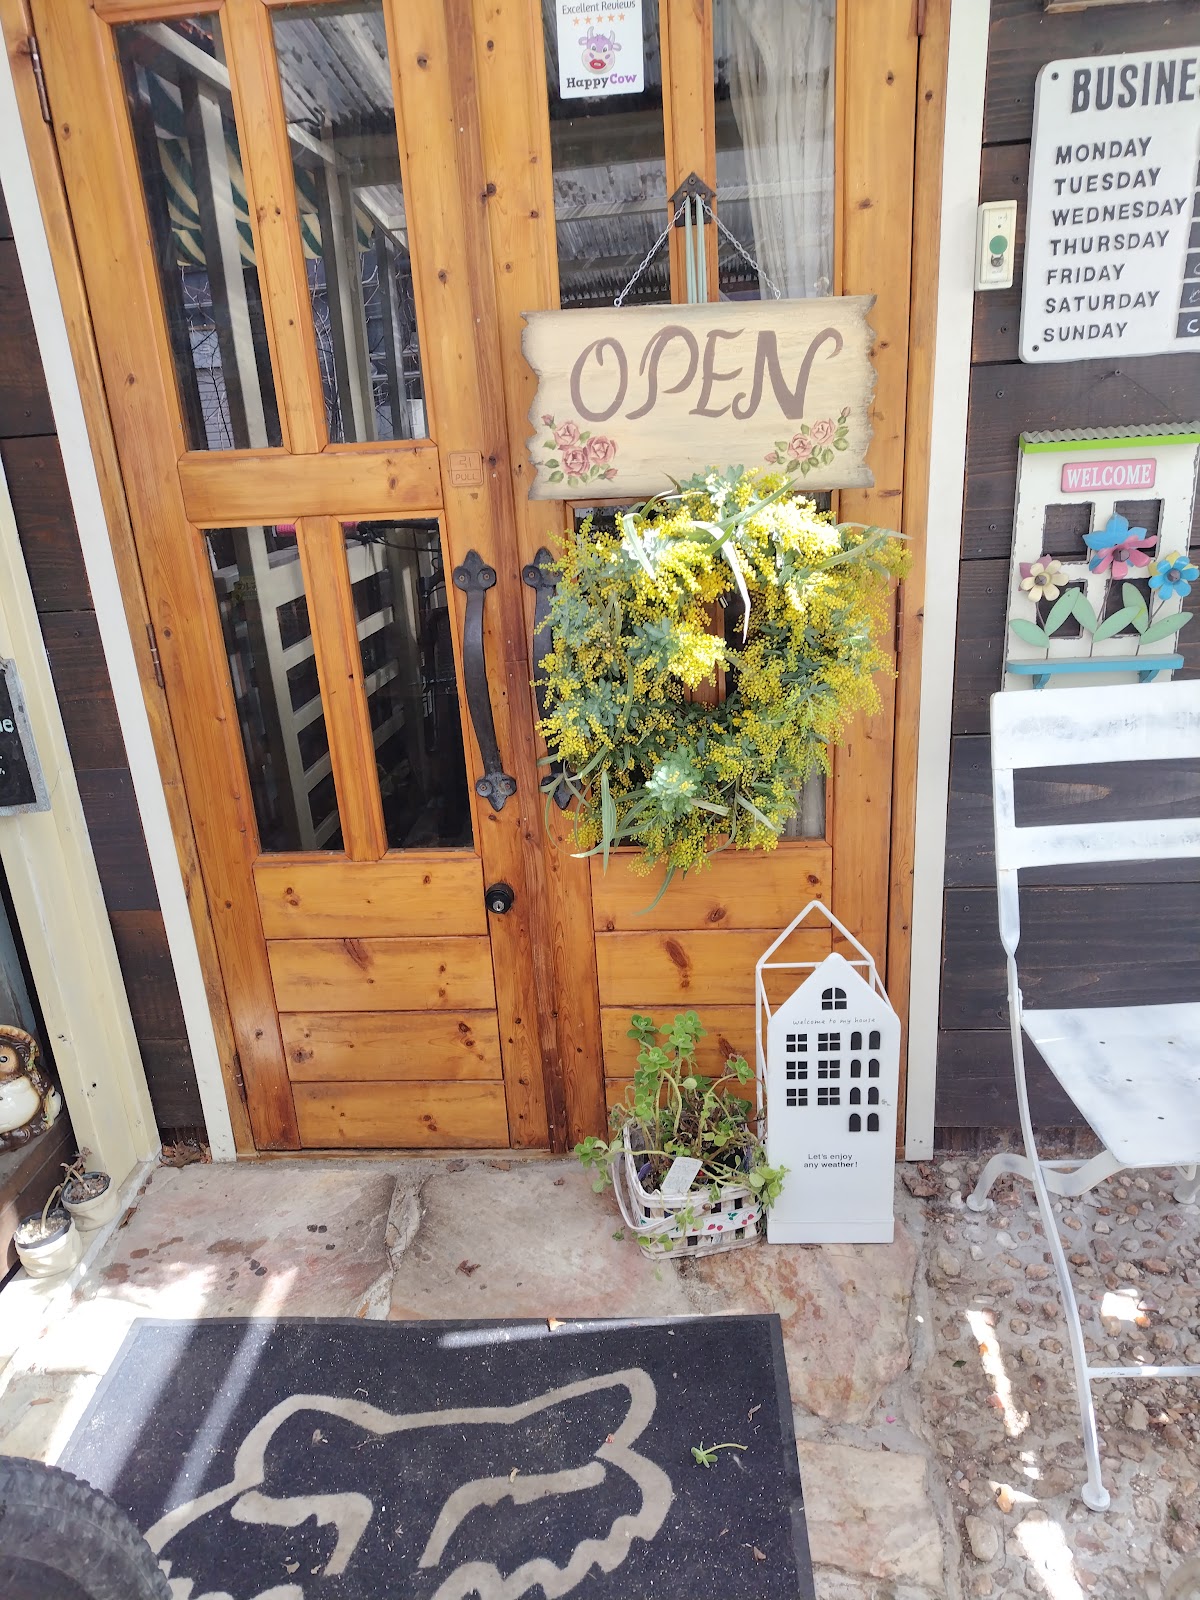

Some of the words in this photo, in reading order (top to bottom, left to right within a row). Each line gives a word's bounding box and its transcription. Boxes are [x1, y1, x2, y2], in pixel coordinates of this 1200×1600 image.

[562, 3, 600, 15] Excellent
[601, 0, 636, 11] Reviews
[566, 72, 637, 90] HappyCow
[1071, 58, 1200, 113] BUSINE
[1055, 136, 1152, 165] MONDAY
[1054, 167, 1161, 196] TUESDAY
[1052, 197, 1188, 227] WEDNESDAY
[1050, 230, 1170, 256] THURSDAY
[1047, 263, 1125, 285] FRIDAY
[1045, 290, 1161, 314] SATURDAY
[1043, 321, 1129, 342] SUNDAY
[570, 325, 844, 422] OPEN
[455, 473, 478, 481] PULL
[1067, 464, 1152, 489] WELCOME
[792, 1018, 826, 1026] welcome
[854, 1016, 876, 1024] house
[803, 1162, 819, 1170] any
[829, 1153, 853, 1161] enjoy
